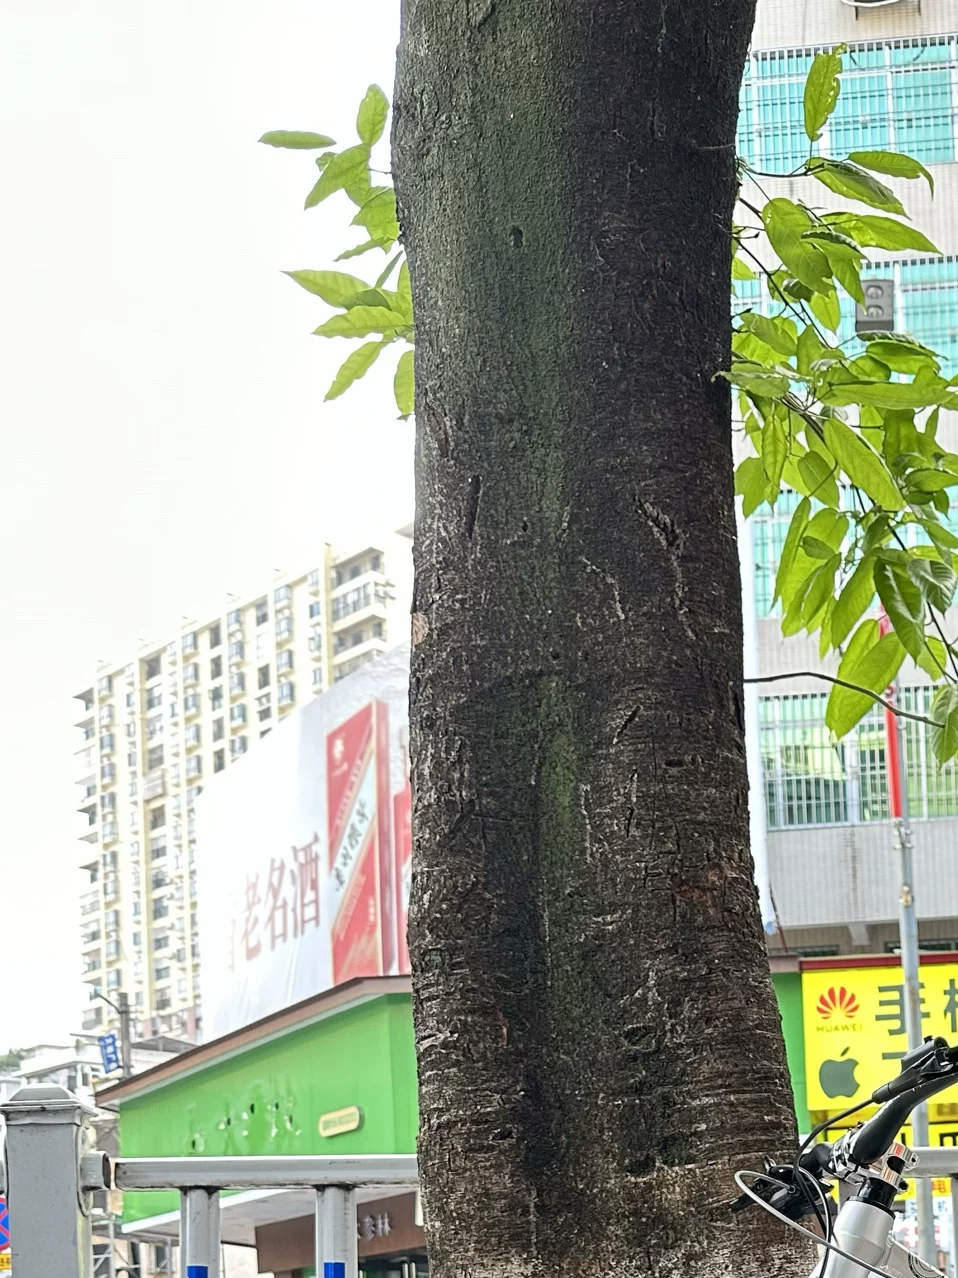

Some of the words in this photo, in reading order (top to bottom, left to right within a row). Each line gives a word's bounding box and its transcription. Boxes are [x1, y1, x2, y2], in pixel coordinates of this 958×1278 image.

[226, 829, 320, 972] 老名酒
[816, 1023, 863, 1033] HUAWEI
[357, 1212, 391, 1241] 参林
